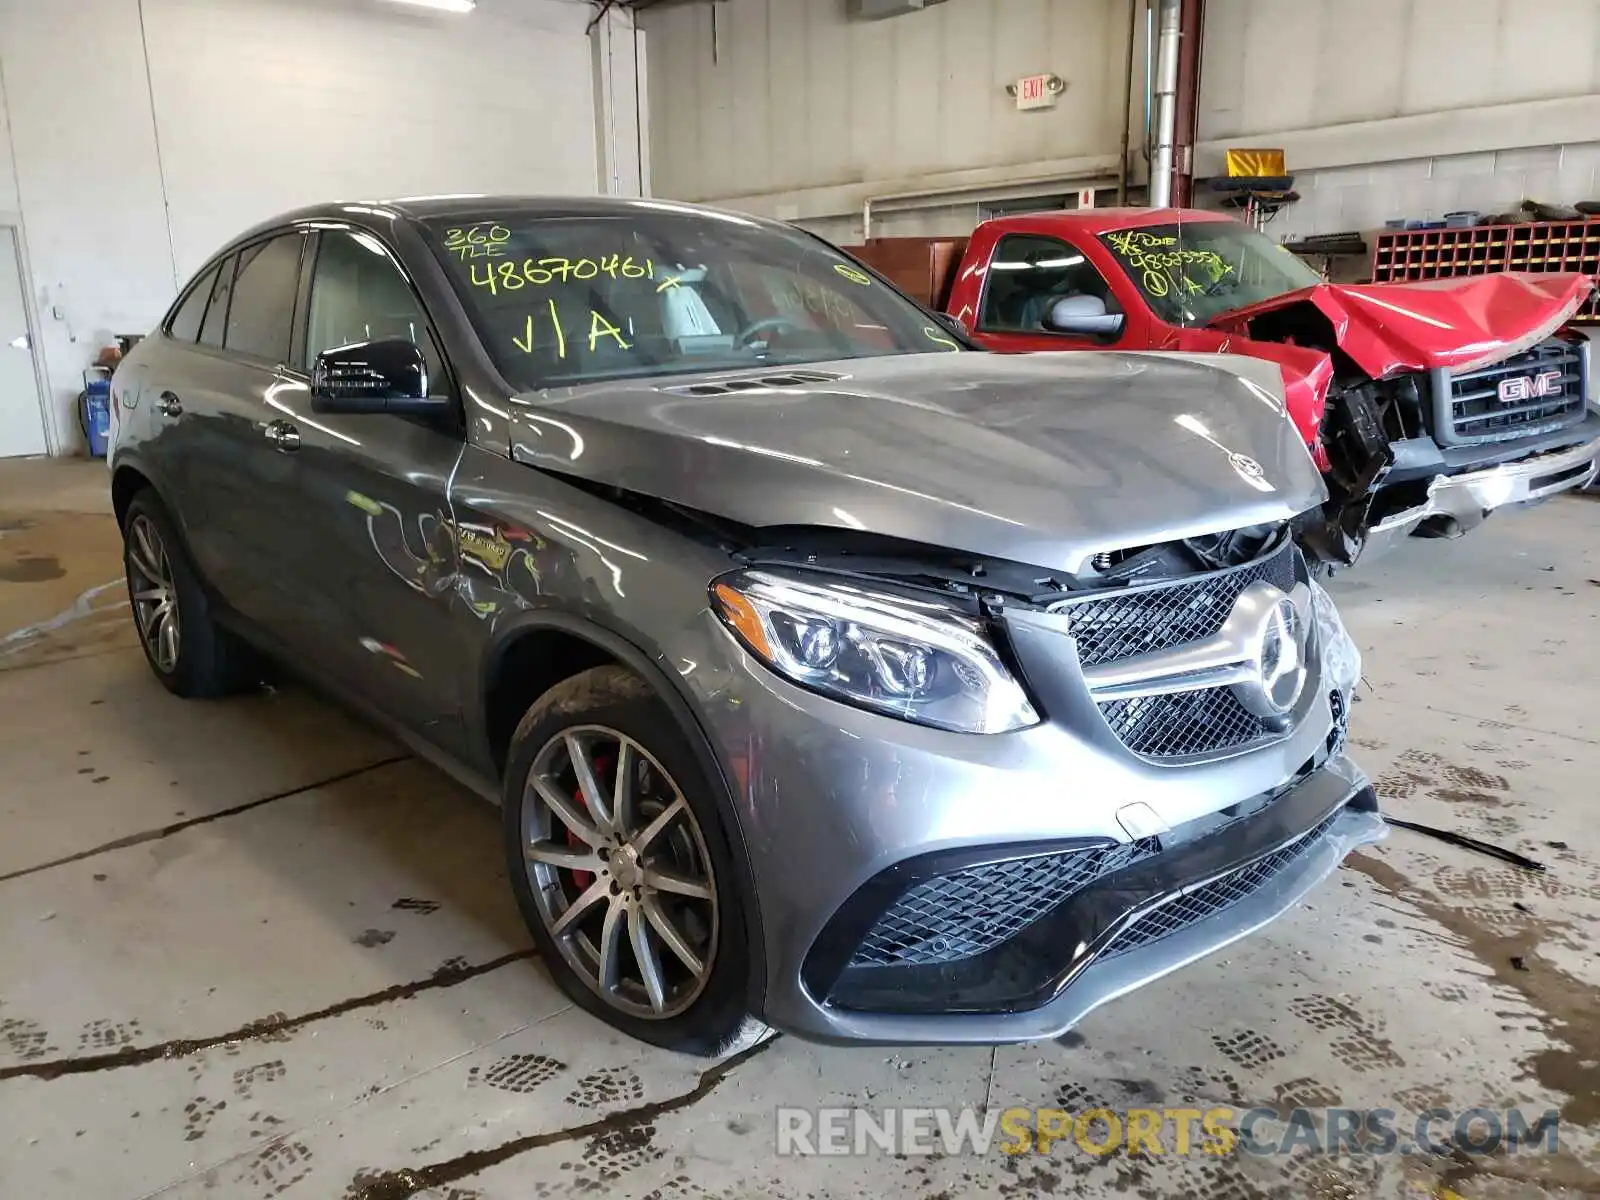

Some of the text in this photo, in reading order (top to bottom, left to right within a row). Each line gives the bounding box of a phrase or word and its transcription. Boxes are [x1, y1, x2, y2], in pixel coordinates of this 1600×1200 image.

[1023, 78, 1044, 99] EXIT
[444, 225, 511, 246] 360
[470, 253, 654, 296] 48670461
[1498, 371, 1562, 402] GMC
